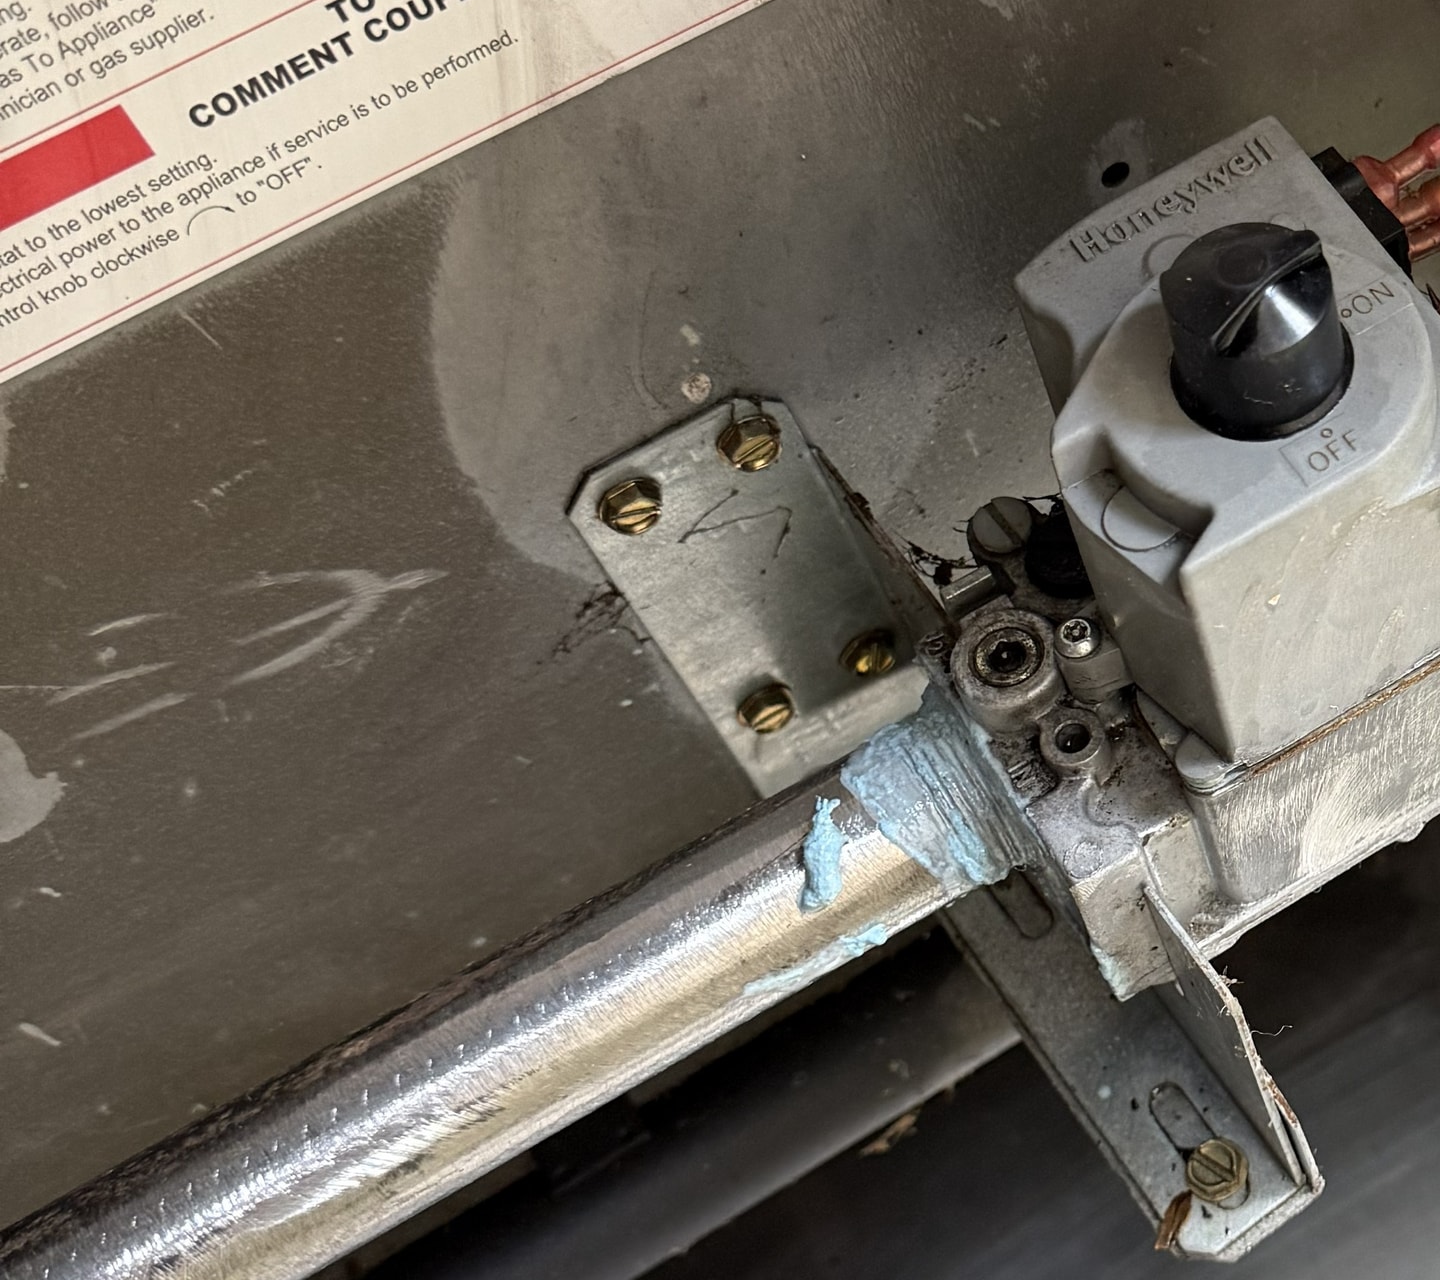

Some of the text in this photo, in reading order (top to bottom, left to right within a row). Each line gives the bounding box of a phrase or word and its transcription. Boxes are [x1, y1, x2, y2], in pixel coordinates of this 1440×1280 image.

[188, 30, 355, 128] COMMENT
[57, 28, 519, 270] power to the appliance if service is to be performed.
[1069, 135, 1278, 263] Honeywell
[1352, 282, 1395, 315] ON
[1308, 429, 1357, 472] OFF
